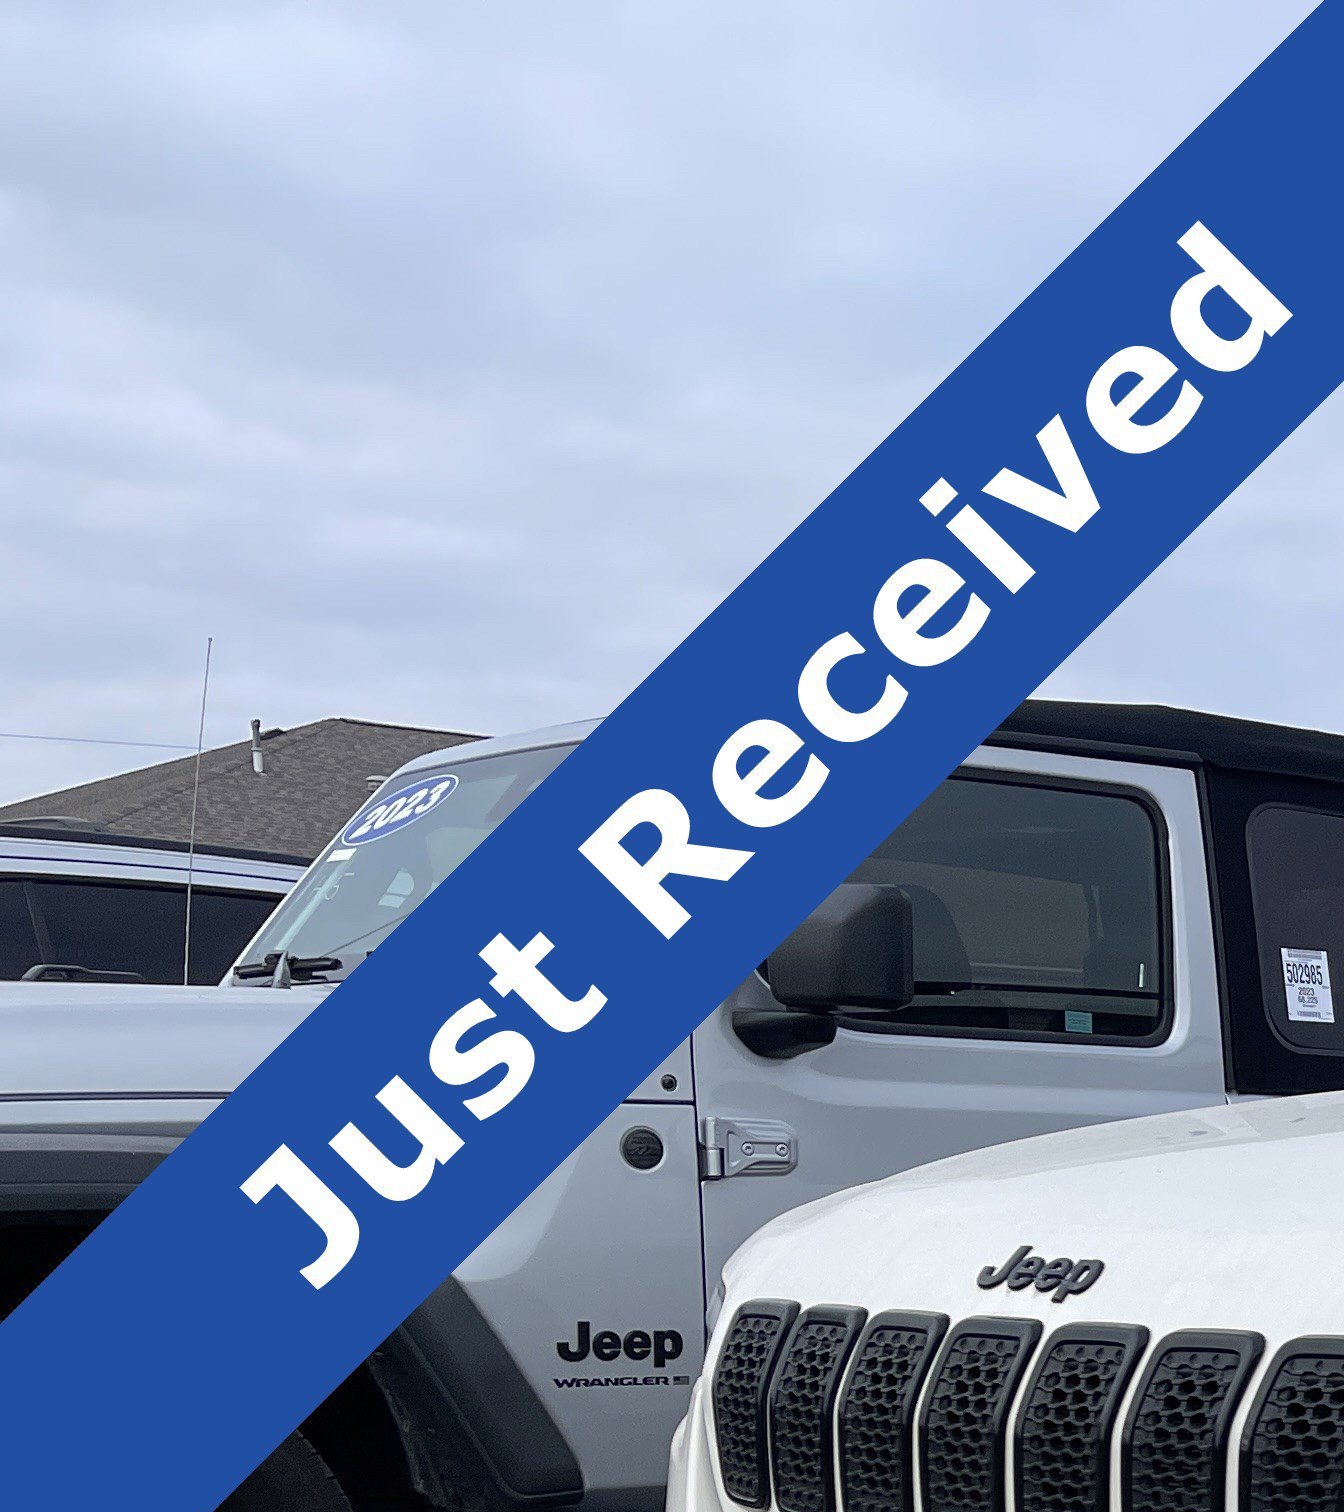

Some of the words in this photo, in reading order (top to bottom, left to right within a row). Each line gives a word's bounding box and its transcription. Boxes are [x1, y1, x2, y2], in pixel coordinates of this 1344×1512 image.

[348, 780, 451, 840] 2023
[1285, 962, 1323, 986] 502985
[977, 1245, 1105, 1304] Jeep
[556, 1320, 684, 1368] Jeep
[553, 1375, 670, 1389] WRANGLER
